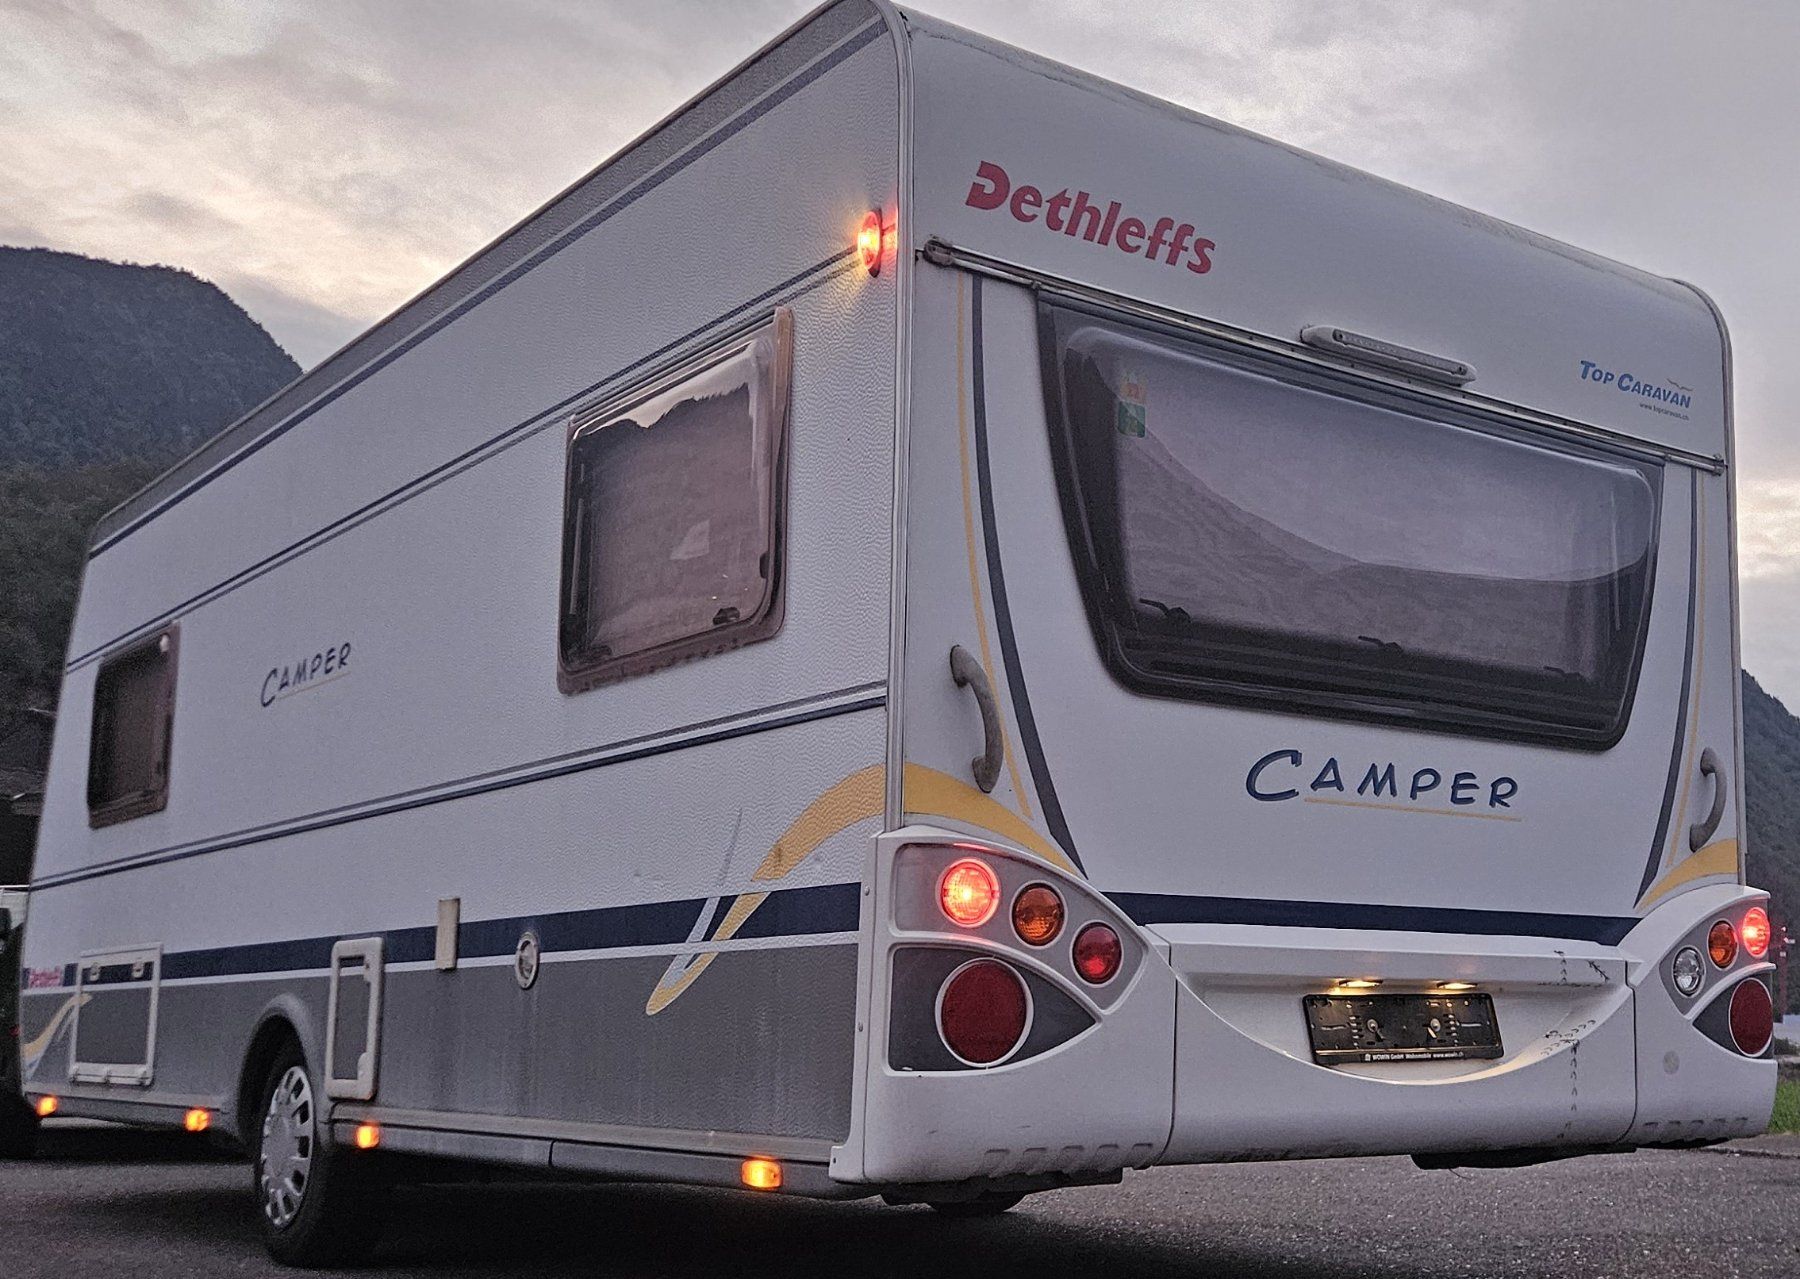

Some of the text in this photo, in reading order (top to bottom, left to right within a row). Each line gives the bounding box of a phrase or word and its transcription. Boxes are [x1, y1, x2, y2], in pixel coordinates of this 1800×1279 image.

[965, 160, 1216, 274] Dethleffs
[261, 642, 351, 708] CAMPER
[1246, 749, 1519, 808] CAMPER
